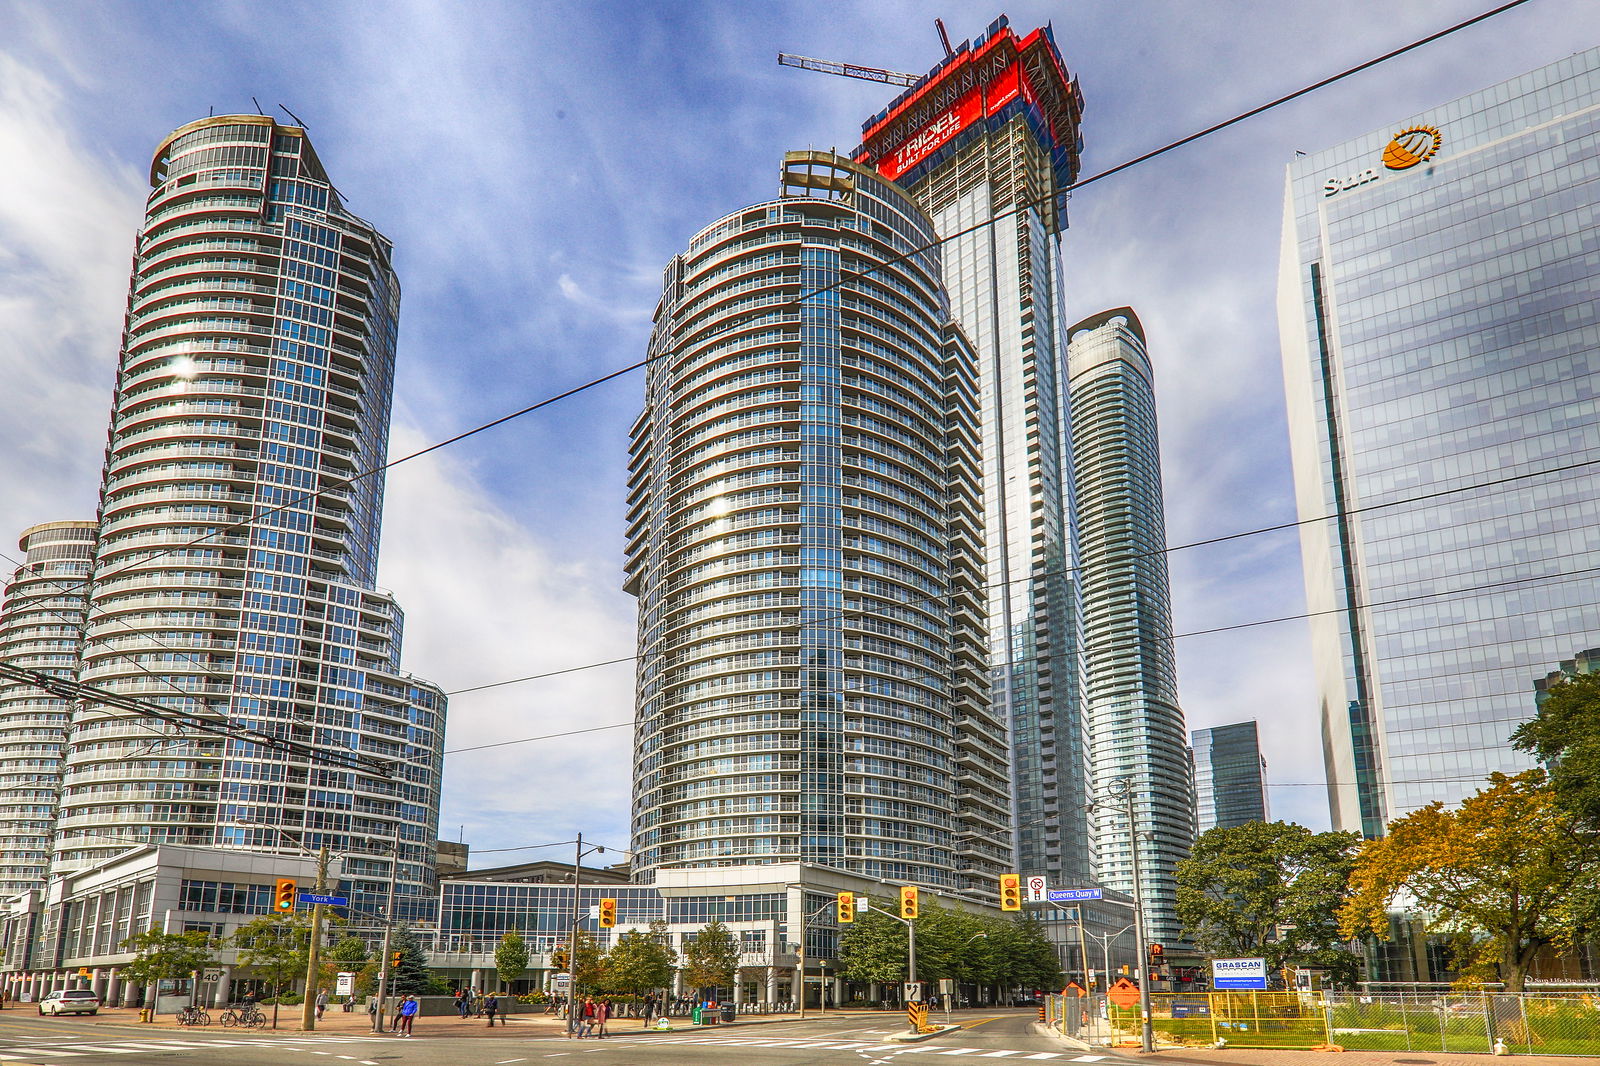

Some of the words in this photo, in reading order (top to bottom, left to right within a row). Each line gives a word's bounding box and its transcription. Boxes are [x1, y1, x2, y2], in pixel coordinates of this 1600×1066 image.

[894, 111, 960, 164] TRIDEL
[896, 151, 920, 174] BUILT
[921, 137, 940, 155] FOR
[942, 120, 961, 140] LIFE
[1324, 168, 1380, 198] Sun
[311, 894, 329, 903] York
[1050, 890, 1074, 899] Queens
[1075, 889, 1092, 899] Quay
[1093, 889, 1100, 897] W
[1216, 961, 1261, 969] GRASCAN
[204, 973, 219, 982] 40
